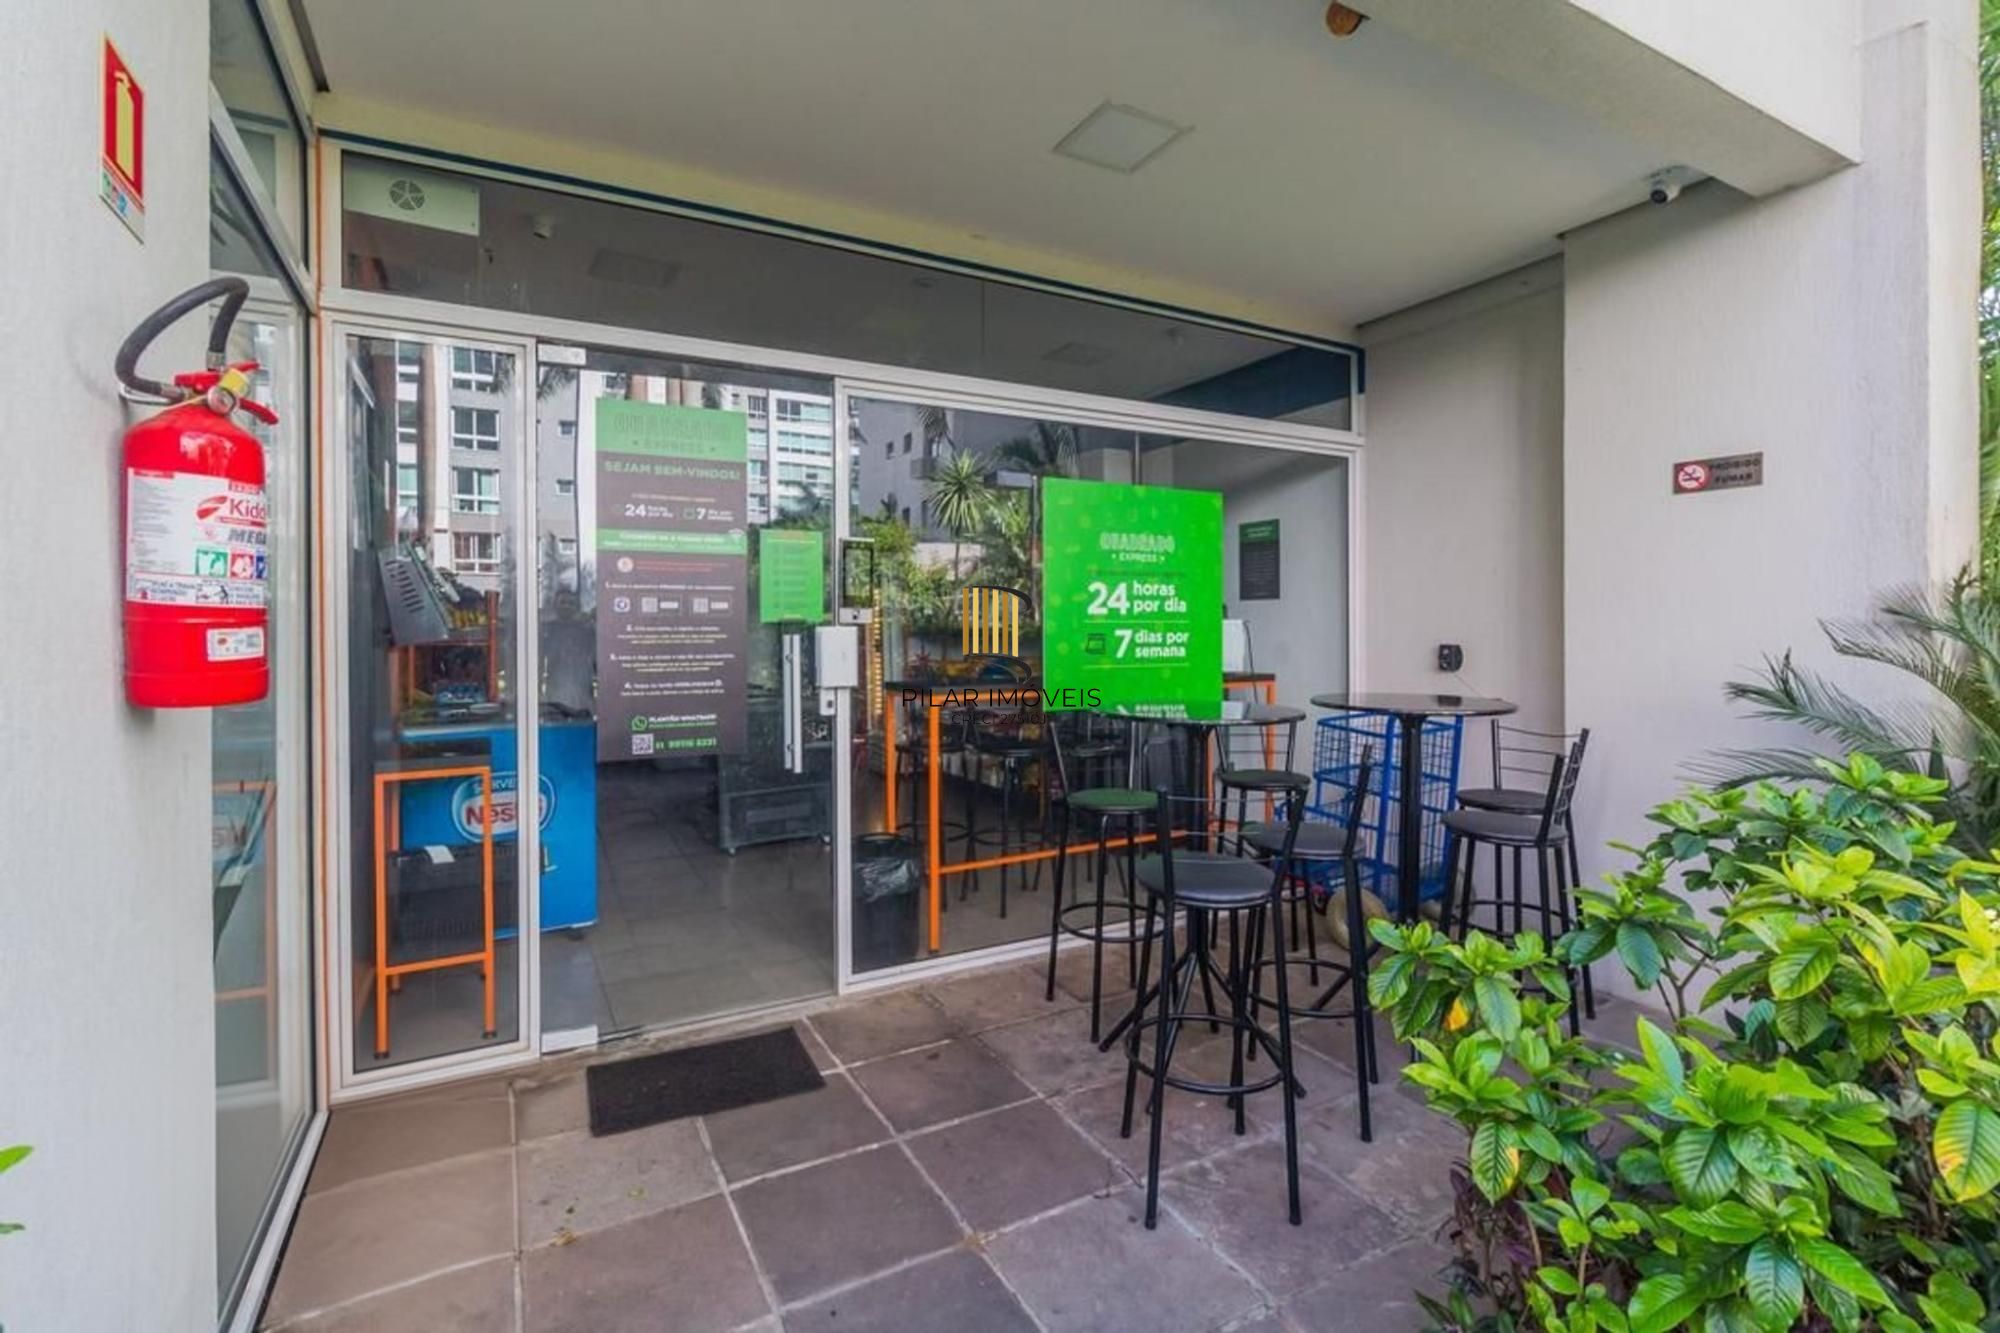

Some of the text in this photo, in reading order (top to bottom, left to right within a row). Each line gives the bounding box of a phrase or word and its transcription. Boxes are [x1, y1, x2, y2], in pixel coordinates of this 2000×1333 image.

[605, 460, 652, 474] SEJAM
[625, 503, 647, 518] 24
[696, 507, 706, 521] 7
[1118, 552, 1158, 563] EXPRESS
[1087, 580, 1176, 615] 24 horas
[1133, 597, 1187, 616] por dia
[1114, 629, 1190, 659] 7 dias por
[1135, 645, 1187, 659] semana
